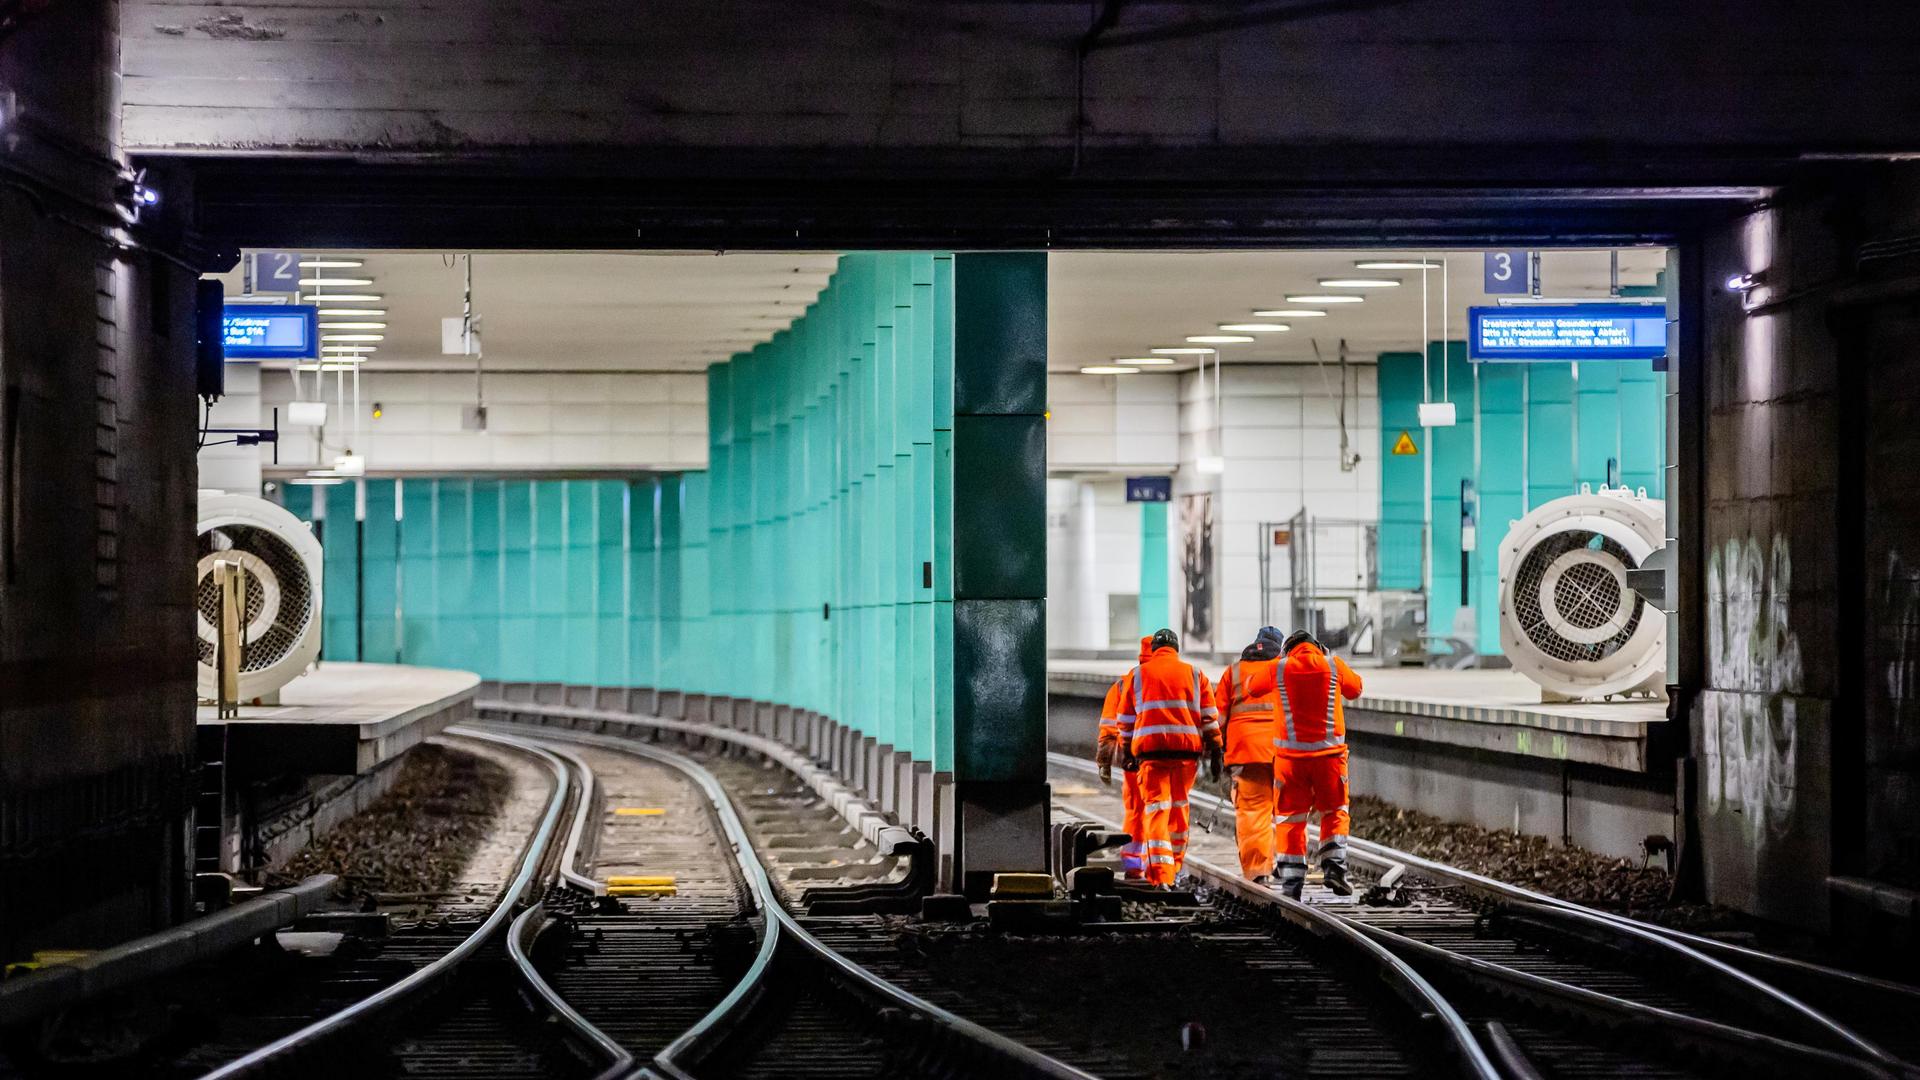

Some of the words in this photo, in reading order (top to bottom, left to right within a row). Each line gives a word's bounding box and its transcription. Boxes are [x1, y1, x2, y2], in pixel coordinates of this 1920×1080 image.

[273, 253, 293, 279] 2
[1493, 252, 1512, 281] 3
[1594, 337, 1608, 345] Bus
